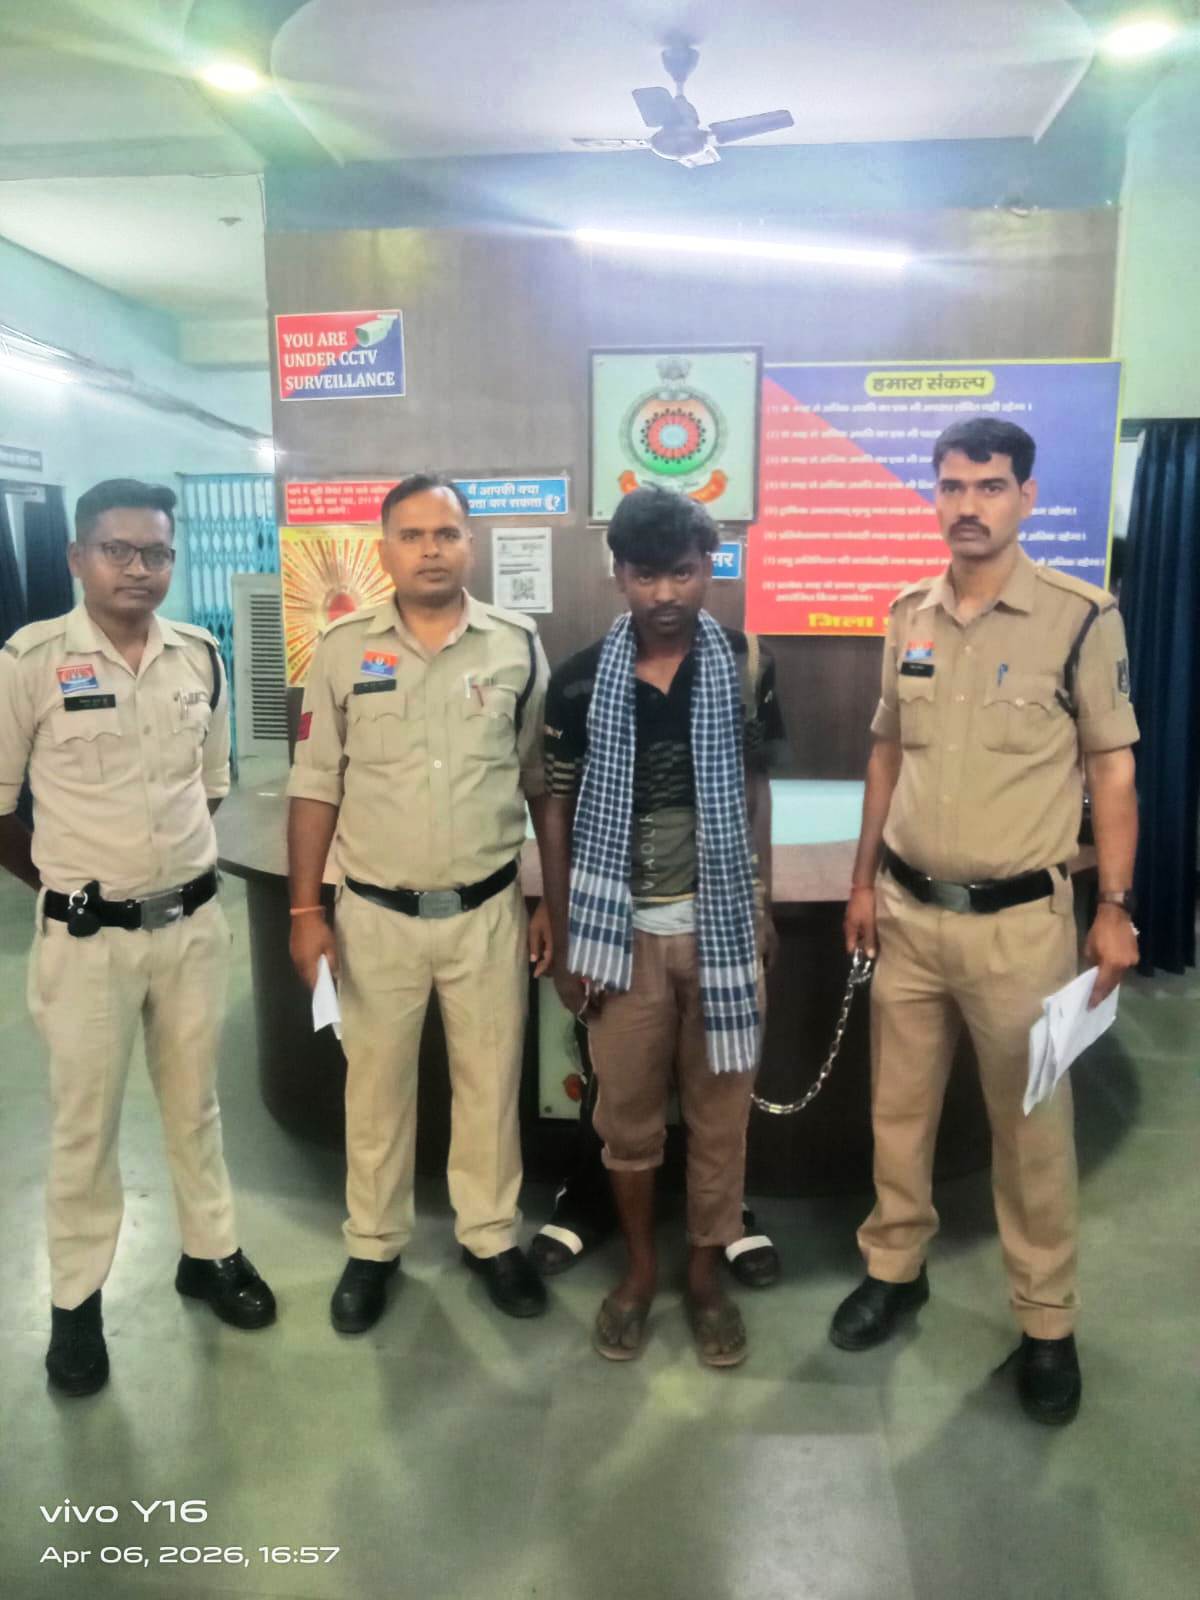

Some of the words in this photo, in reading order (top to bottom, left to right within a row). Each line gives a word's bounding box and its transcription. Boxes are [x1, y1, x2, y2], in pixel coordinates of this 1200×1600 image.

[283, 332, 313, 348] YOU
[317, 331, 347, 346] ARE
[284, 352, 336, 368] UNDER
[340, 349, 377, 366] CCTV
[286, 371, 396, 390] SURVEILLANCE
[872, 377, 924, 392] हमारा
[926, 372, 986, 390] संकल्प
